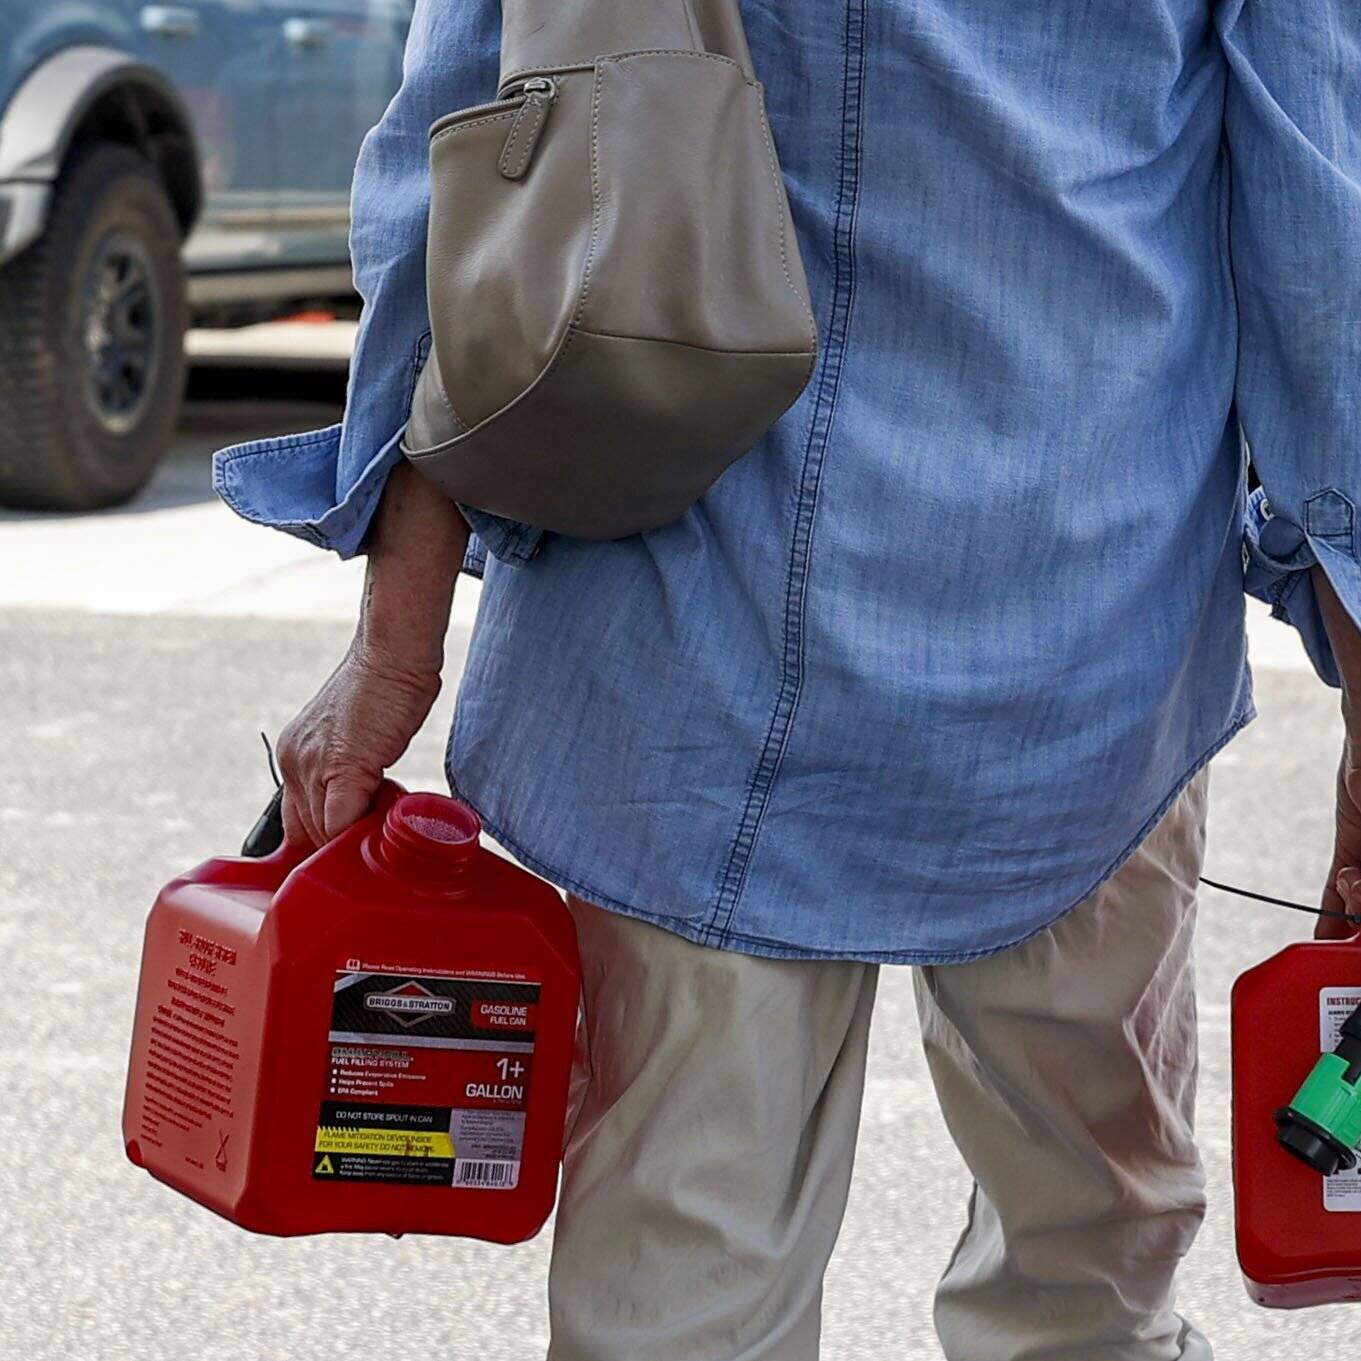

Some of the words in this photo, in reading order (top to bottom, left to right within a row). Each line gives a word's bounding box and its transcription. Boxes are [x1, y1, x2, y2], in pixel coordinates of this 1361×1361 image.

[480, 1004, 528, 1017] GASOLINE
[490, 1015, 508, 1025] FUEL
[509, 1017, 526, 1026] CAN
[331, 1057, 349, 1065] FUEL
[379, 1060, 409, 1068] SYSTEM
[496, 1057, 525, 1081] 1+
[465, 1082, 523, 1099] GALLON
[336, 1110, 347, 1119] DO
[347, 1111, 362, 1120] NOT
[363, 1112, 385, 1121] STORE
[385, 1113, 408, 1123] SPOUT
[409, 1115, 417, 1123] IN
[417, 1115, 433, 1124] CAN
[323, 1131, 346, 1139] FLAME
[347, 1132, 385, 1141] MITIGATION
[319, 1140, 334, 1148] FOR
[334, 1141, 353, 1149] YOUR
[354, 1142, 378, 1150] SAFETY
